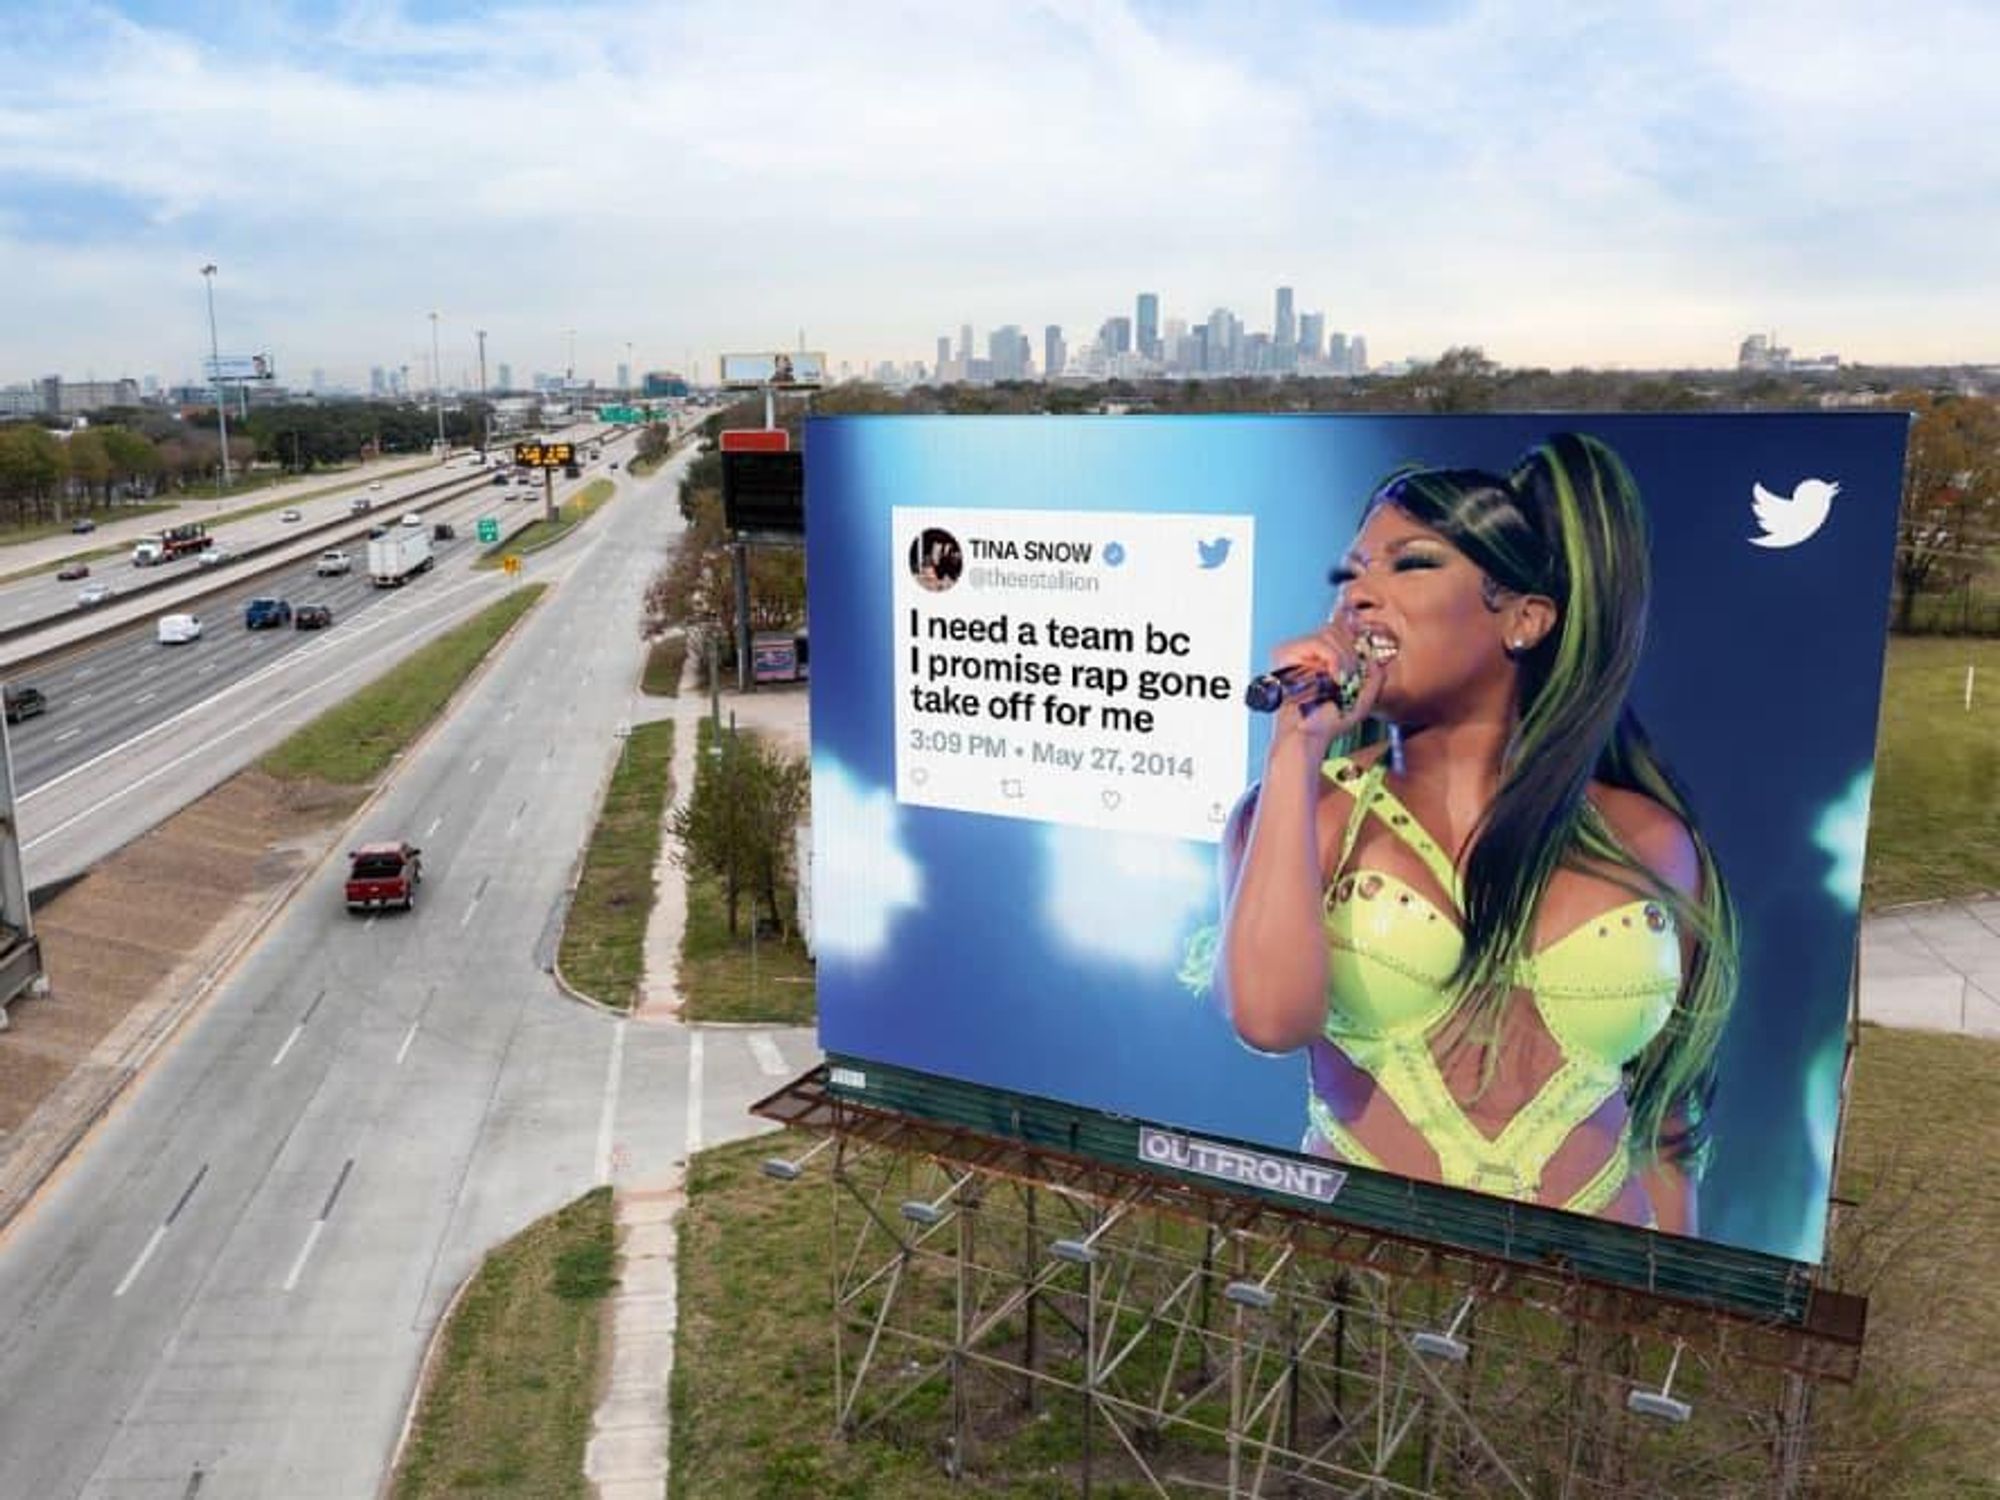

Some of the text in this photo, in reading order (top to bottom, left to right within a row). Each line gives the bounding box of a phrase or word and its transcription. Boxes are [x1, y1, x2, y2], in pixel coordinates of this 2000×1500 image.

[969, 538, 1094, 565] TINA SNOW
[910, 608, 1191, 656] I need a team bc
[911, 646, 1232, 701] I promise rap gone
[910, 685, 1155, 734] take off for me
[910, 729, 962, 754] 3:09
[969, 735, 1006, 759] PM
[1032, 741, 1083, 771] May
[1091, 749, 1125, 776] 27,
[1131, 752, 1194, 779] 2014
[1146, 1135, 1334, 1196] OUTFRONT
